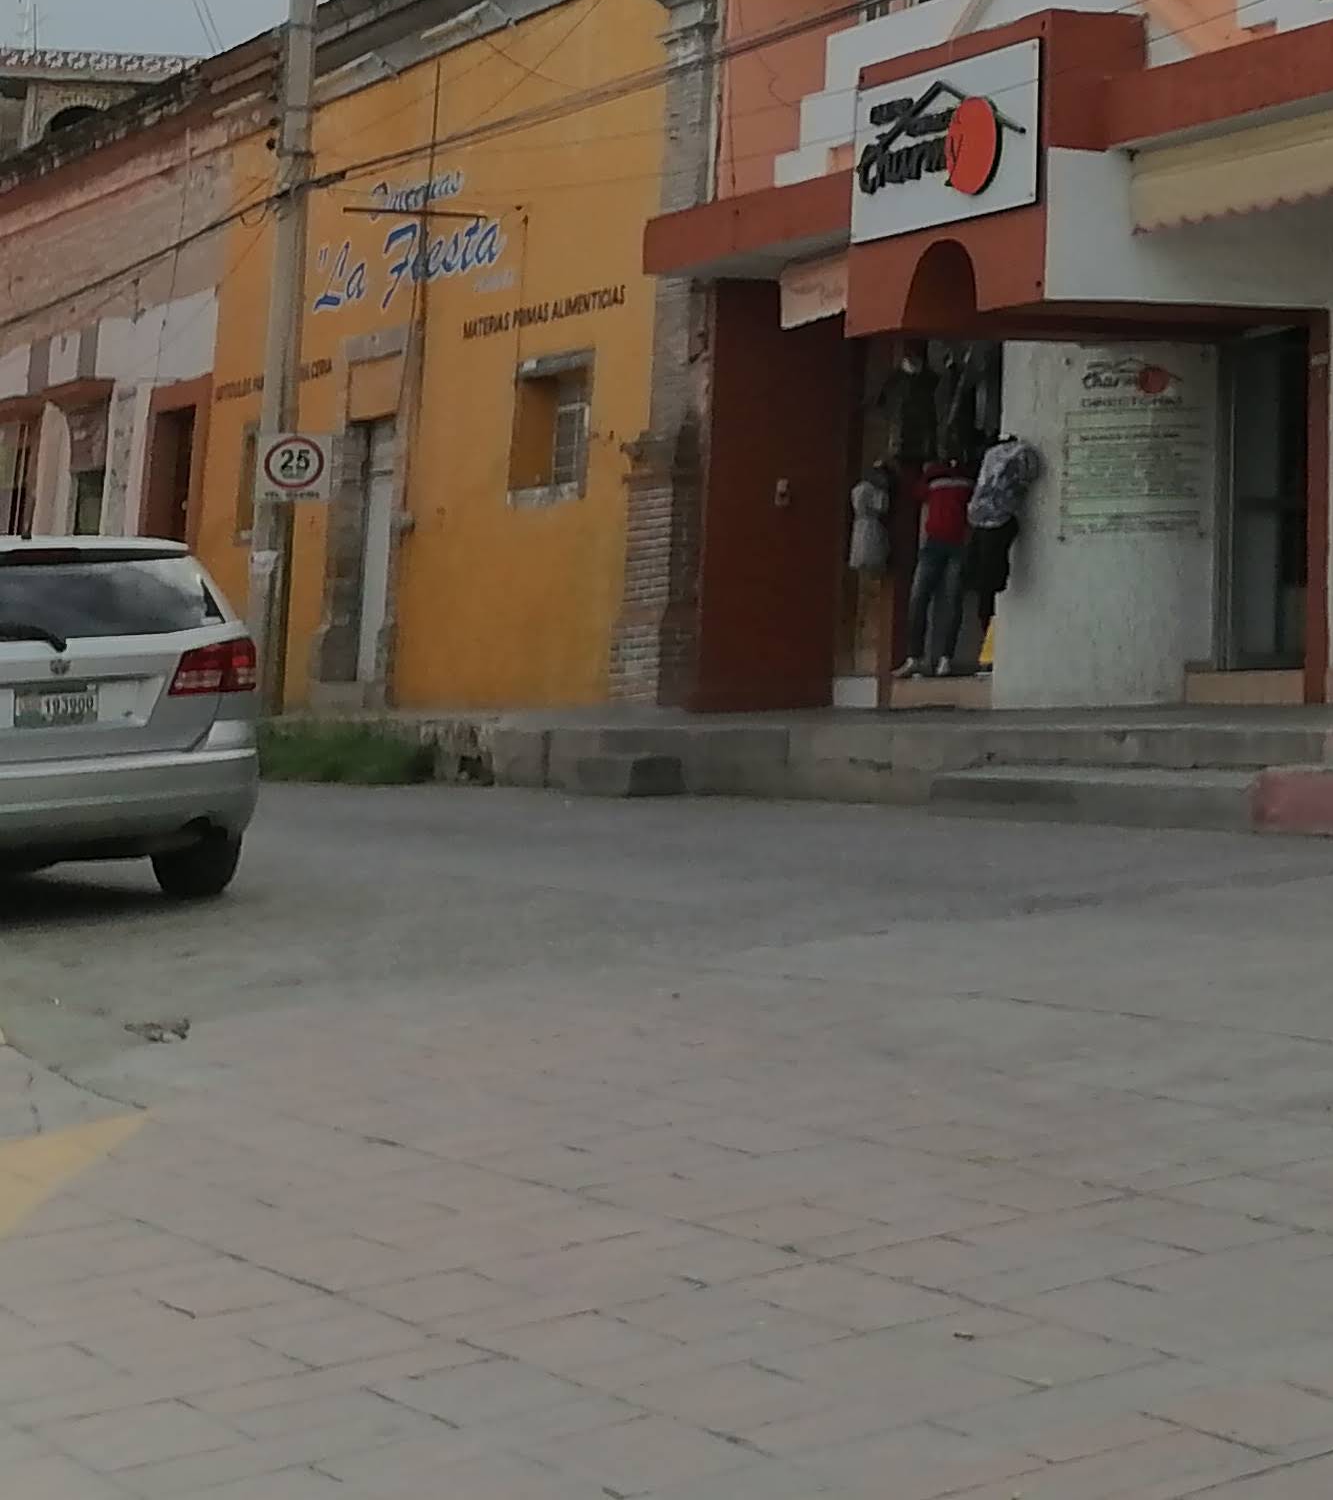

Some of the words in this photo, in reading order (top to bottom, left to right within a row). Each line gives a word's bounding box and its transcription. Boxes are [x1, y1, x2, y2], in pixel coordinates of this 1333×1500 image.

[462, 311, 511, 339] MATERIAS
[512, 302, 549, 329] PRIMAS
[550, 284, 626, 321] ALIMENTICIAS
[280, 448, 311, 472] 25
